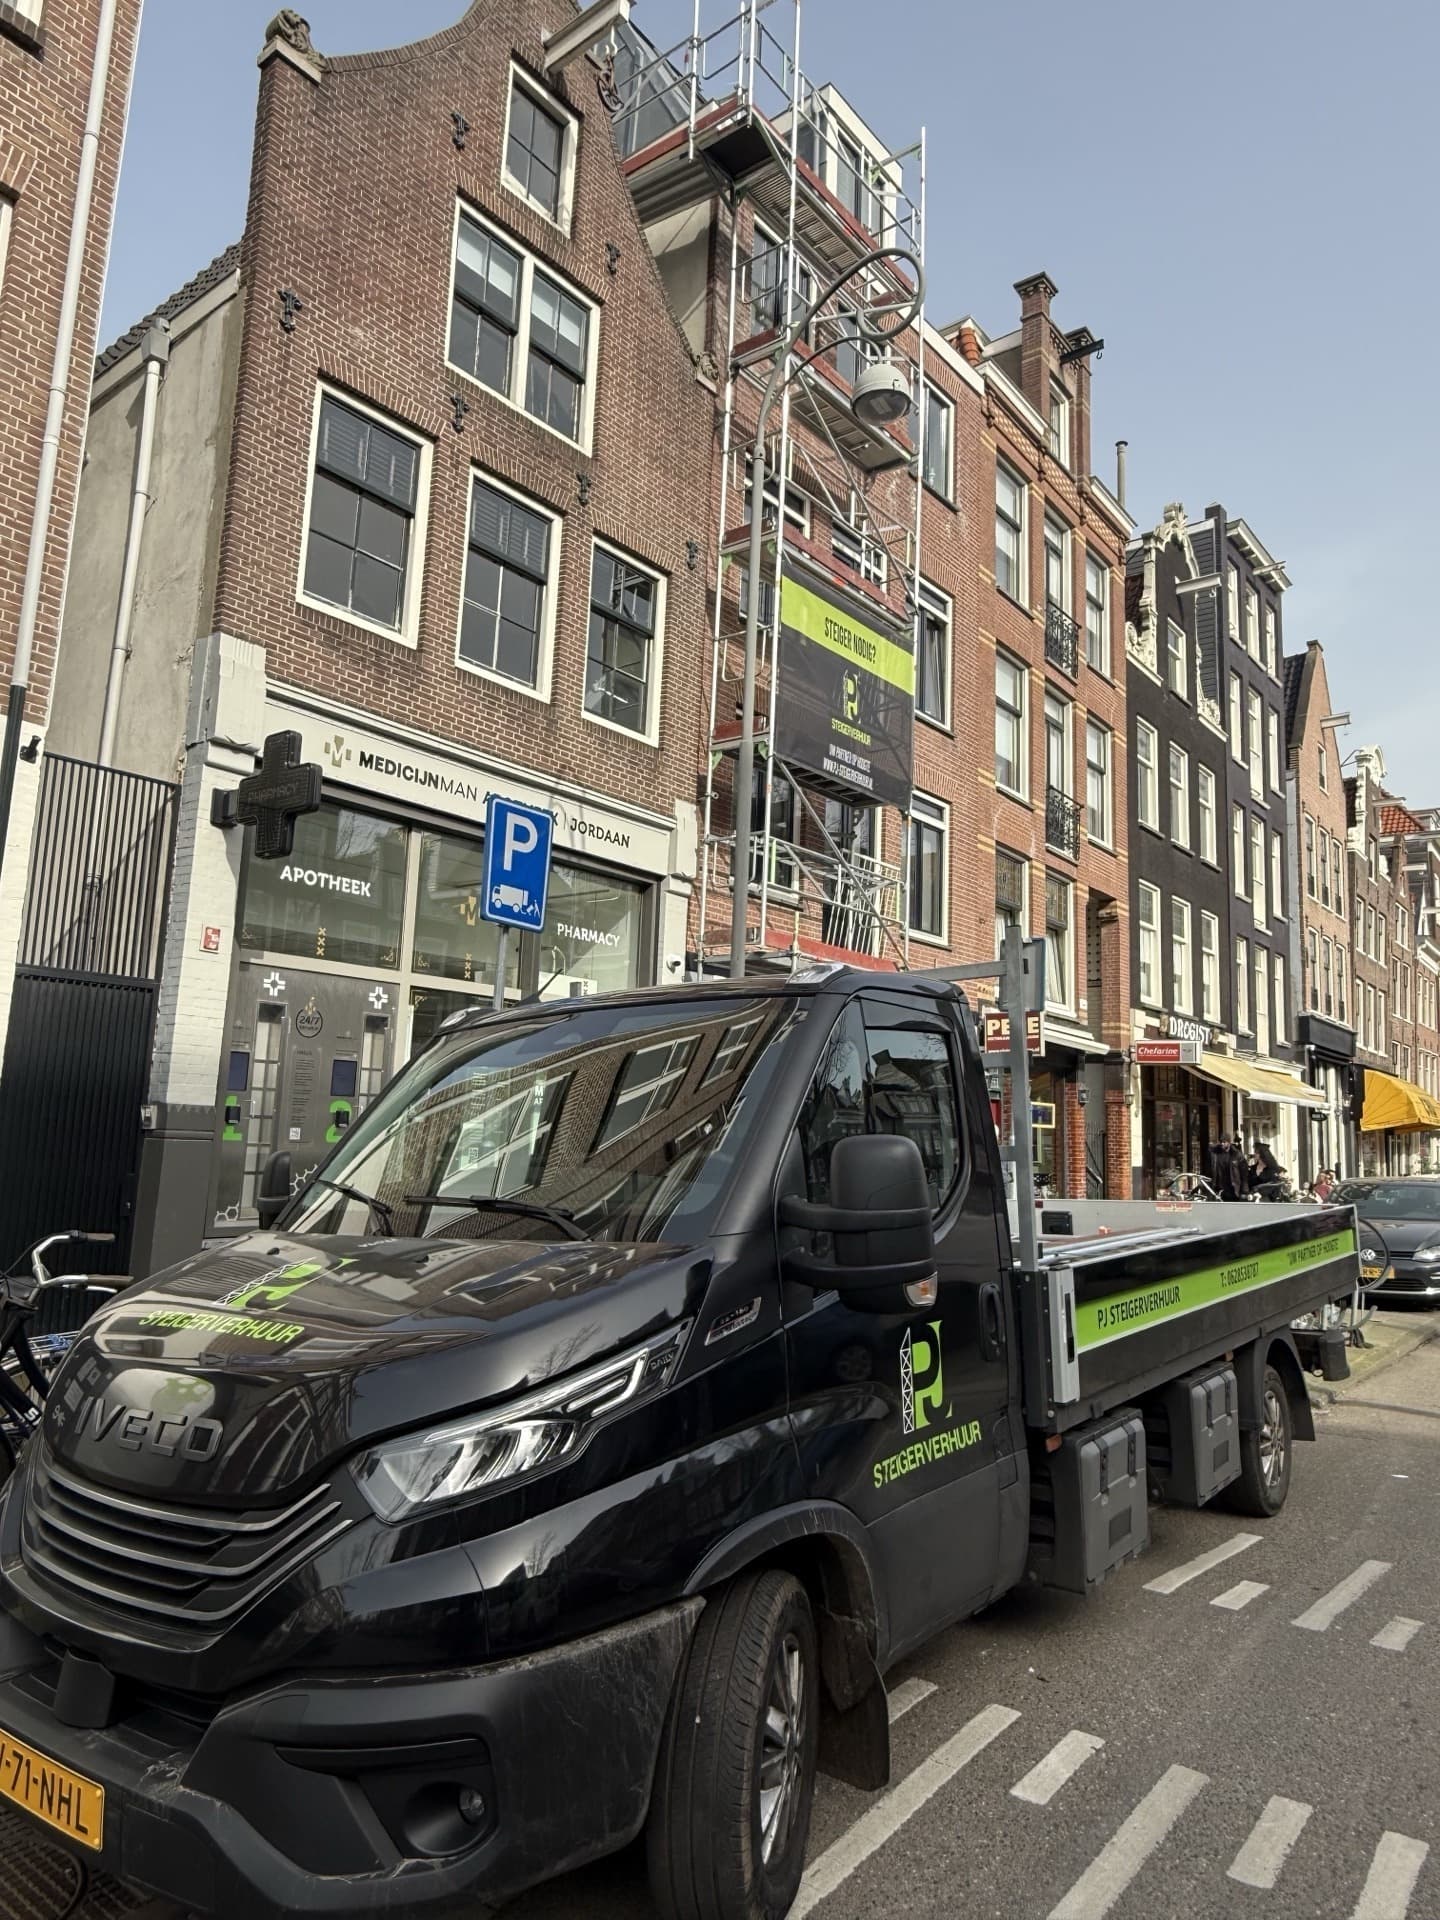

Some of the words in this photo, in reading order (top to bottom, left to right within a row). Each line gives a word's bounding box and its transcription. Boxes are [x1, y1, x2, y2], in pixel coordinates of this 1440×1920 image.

[824, 616, 853, 651] STEIGER
[853, 633, 877, 664] NODIG?
[358, 750, 478, 802] MEDICIJNMAN
[503, 811, 538, 872] P
[569, 817, 631, 849] JORDAAN
[279, 865, 372, 897] APOTHEEK
[557, 922, 621, 948] PHARMACY
[299, 1015, 321, 1026] 24/7
[986, 1016, 1040, 1036] PEE
[1169, 1015, 1211, 1046] DROGIST
[1138, 1046, 1179, 1056] Chefarine
[1097, 1307, 1108, 1330] PJ
[1110, 1285, 1181, 1326] STEIGERVERHUUR
[138, 1310, 305, 1344] STEIGERVERHUUR
[74, 1396, 224, 1463] IVECO
[872, 1420, 983, 1489] STEIGERVERHUUR
